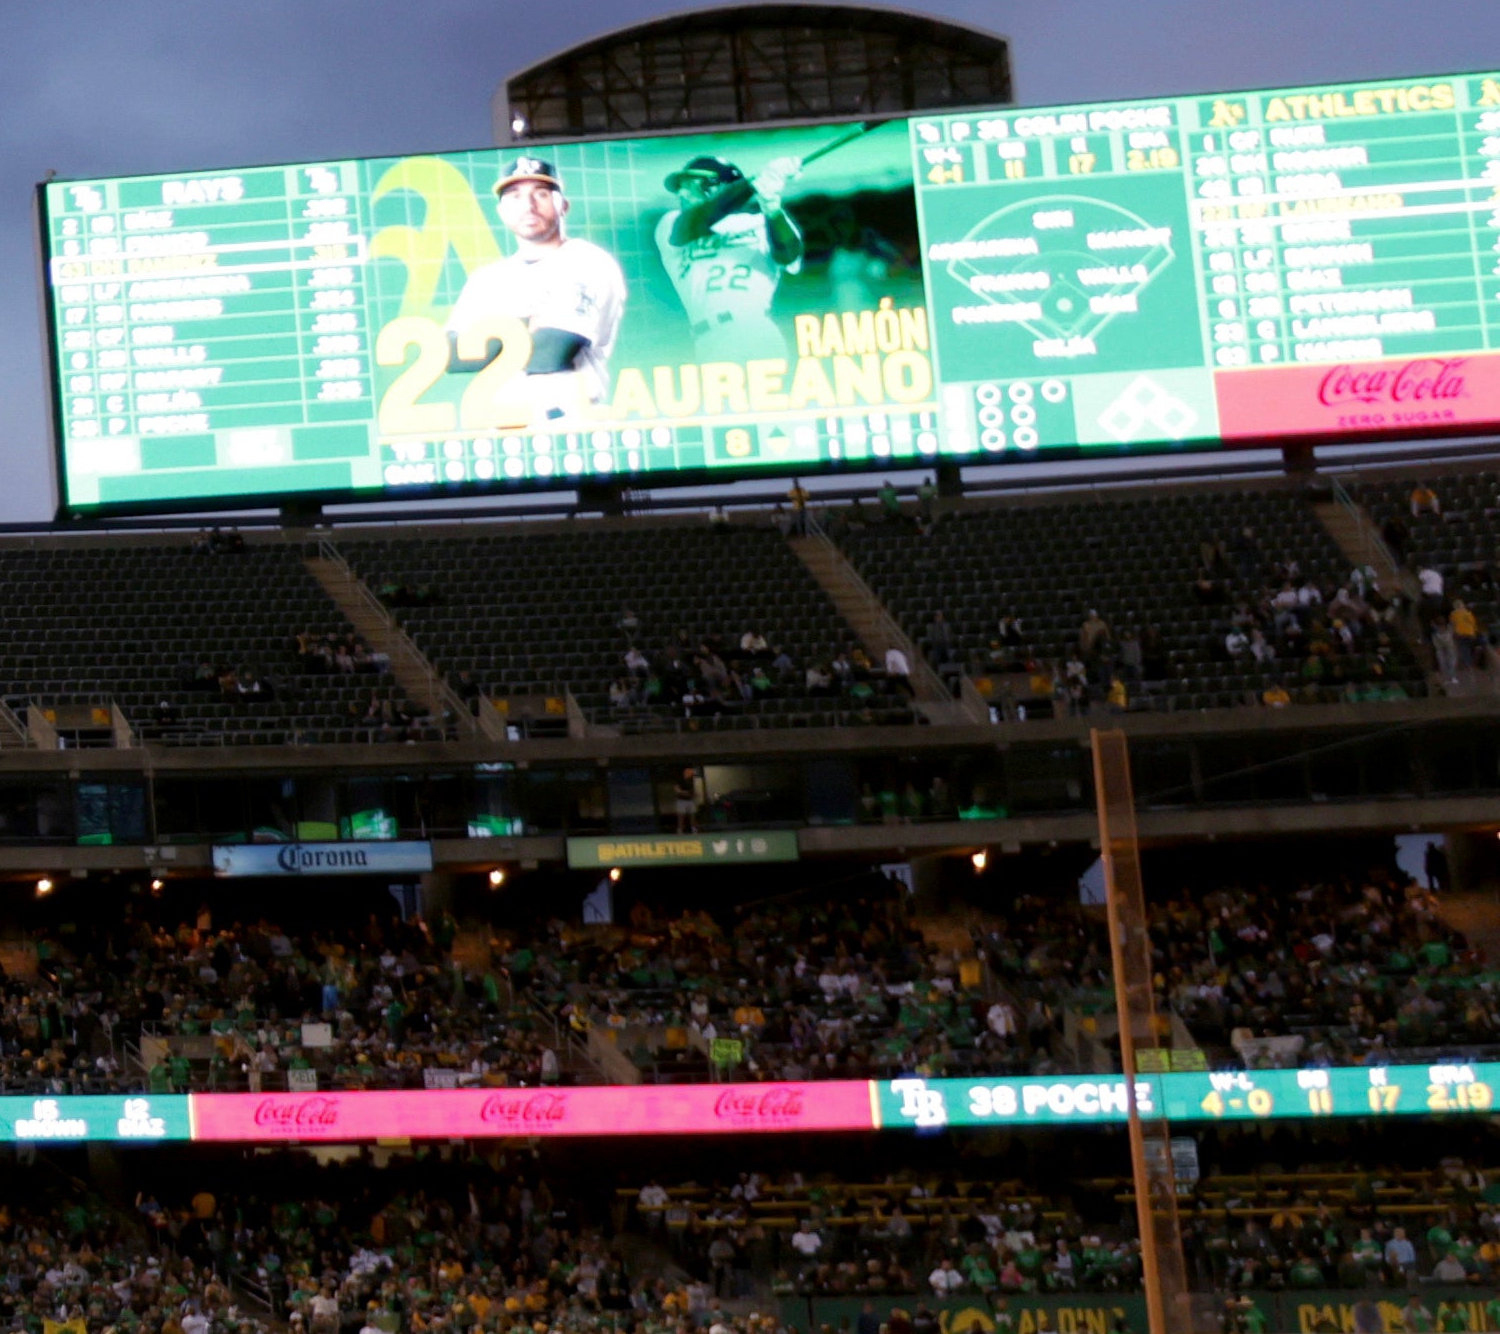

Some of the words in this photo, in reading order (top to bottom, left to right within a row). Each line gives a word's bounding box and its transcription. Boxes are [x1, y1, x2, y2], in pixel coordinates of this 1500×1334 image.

[1266, 84, 1454, 121] ATHLETICS
[951, 122, 970, 141] P
[1014, 115, 1088, 137] COLIN
[1088, 107, 1171, 131] POCHE
[1069, 153, 1096, 174] 17
[1127, 147, 1179, 170] 2.19
[162, 177, 243, 204] RAYS
[1279, 193, 1403, 215] LAUREANO
[705, 264, 752, 292] 22
[795, 297, 929, 357] RAMÓN
[376, 316, 532, 434] 22
[1339, 415, 1384, 427] ZERO
[1392, 410, 1455, 423] SUGAR
[725, 428, 751, 457] 8
[384, 462, 437, 486] OAK
[277, 842, 367, 872] Corona
[1209, 1071, 1254, 1091] W-L
[1430, 1065, 1475, 1085] ERA
[33, 1100, 59, 1121] 15
[125, 1098, 149, 1119] 12
[970, 1085, 1017, 1116] 38
[1023, 1083, 1153, 1116] POCHE
[1308, 1090, 1332, 1114] 11
[1369, 1086, 1402, 1113] 17
[1426, 1084, 1493, 1111] 2.19
[16, 1119, 86, 1139] BROWN
